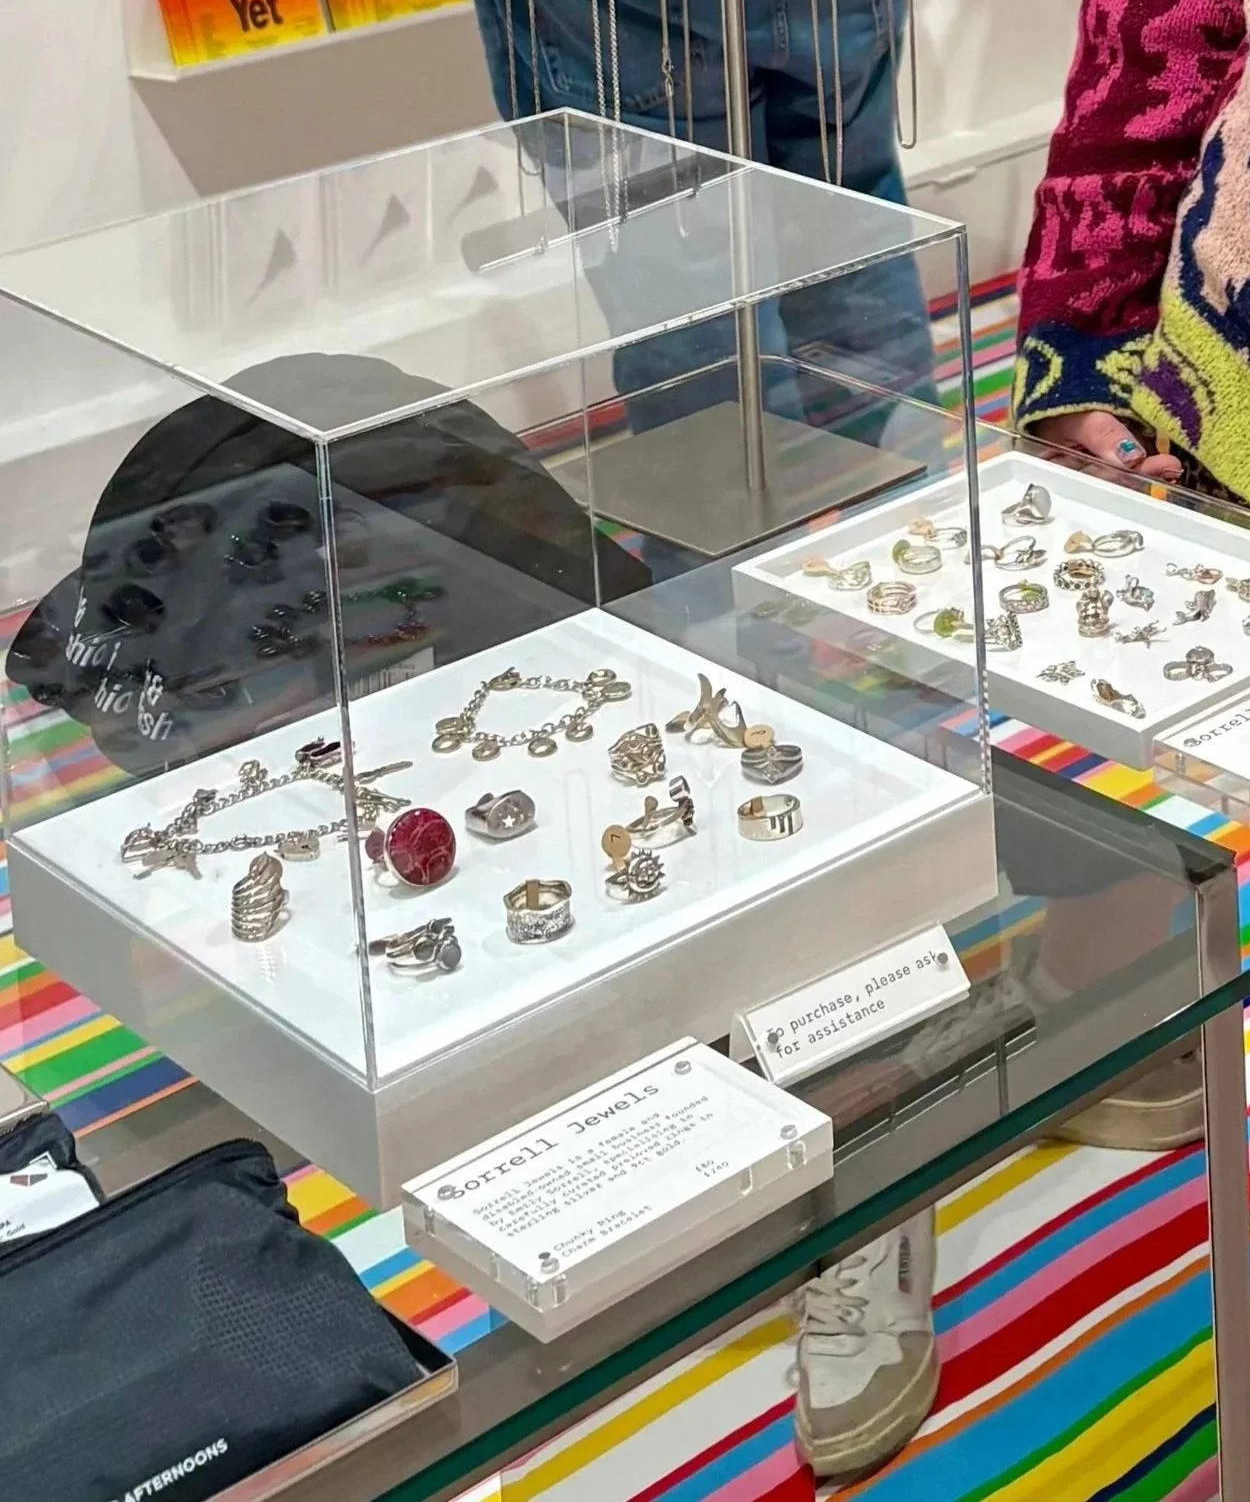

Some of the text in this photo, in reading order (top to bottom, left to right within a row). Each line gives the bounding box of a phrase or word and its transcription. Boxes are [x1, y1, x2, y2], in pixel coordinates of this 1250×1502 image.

[790, 995, 859, 1034] purchase,
[865, 966, 910, 996] please
[916, 951, 940, 969] ask
[776, 1000, 885, 1059] for assistance
[567, 1086, 658, 1134] Jewels
[576, 1151, 608, 1170] small
[611, 1122, 661, 1150] business
[665, 1096, 708, 1120] founded
[473, 1189, 520, 1215] Sorrell
[524, 1166, 563, 1187] Jewels
[598, 1127, 636, 1146] female
[641, 1113, 659, 1125] and
[499, 1198, 556, 1232] carefully
[562, 1170, 606, 1197] curated
[665, 1123, 695, 1141] rings
[507, 1204, 560, 1237] sterling
[564, 1183, 602, 1205] silver
[608, 1169, 627, 1182] and
[508, 1196, 544, 1216] Emily
[554, 1228, 592, 1252] Chunky
[597, 1210, 626, 1226] Ring
[559, 1233, 596, 1258] Charm
[600, 1206, 652, 1236] Bracelet
[123, 1438, 228, 1502] AFTERNOONS
